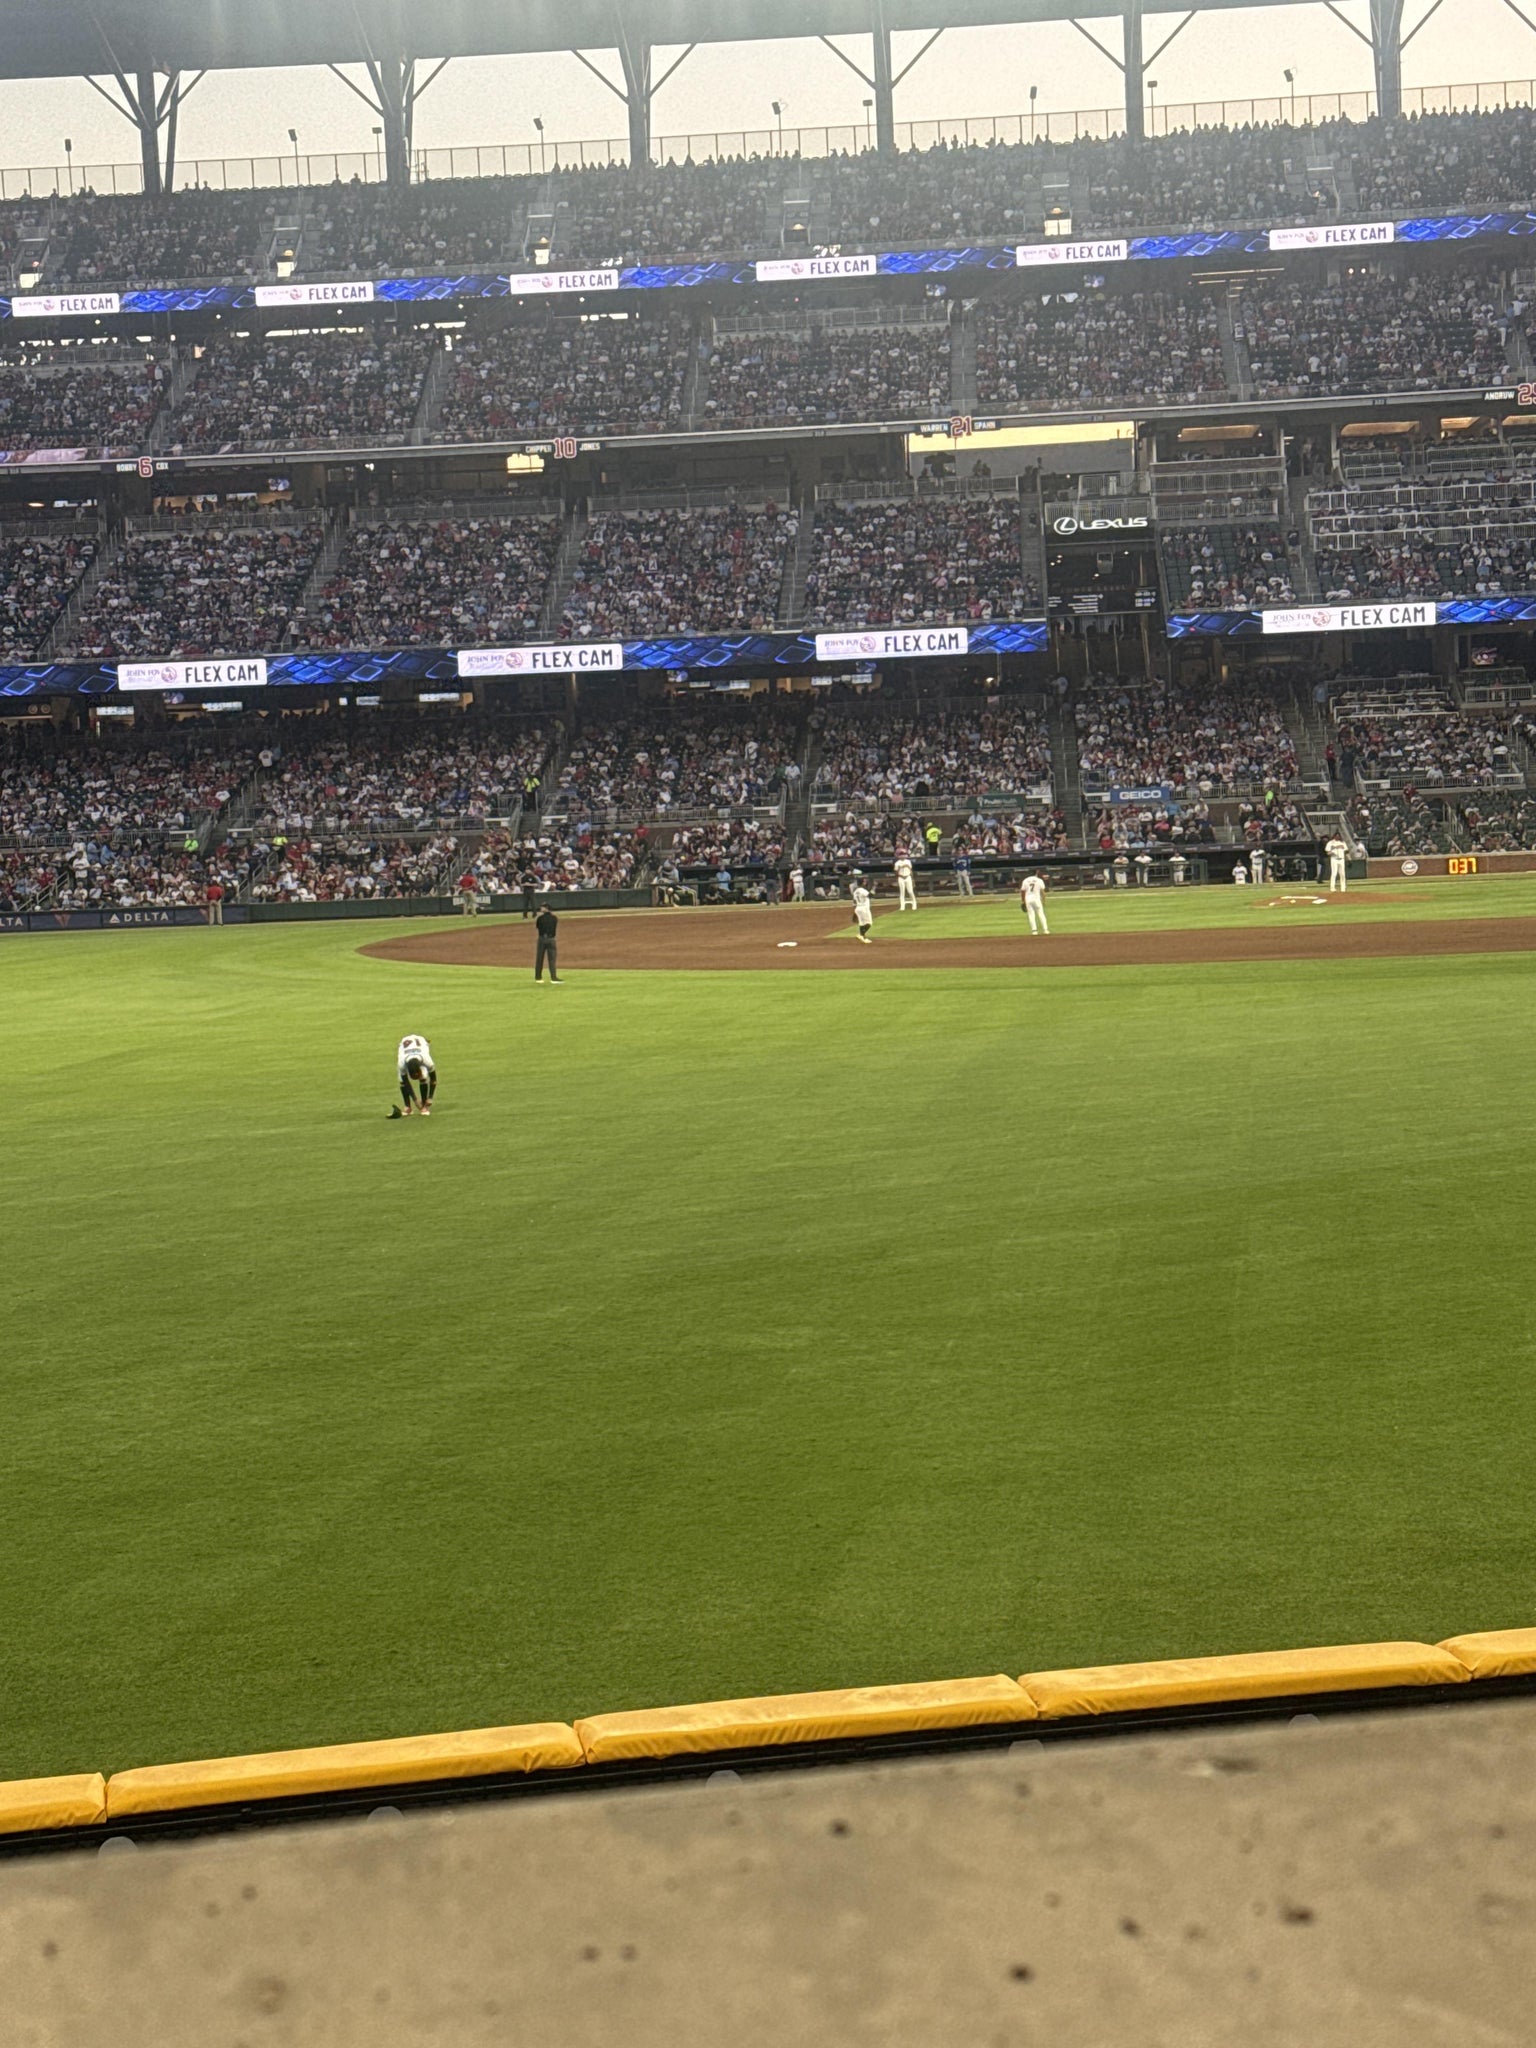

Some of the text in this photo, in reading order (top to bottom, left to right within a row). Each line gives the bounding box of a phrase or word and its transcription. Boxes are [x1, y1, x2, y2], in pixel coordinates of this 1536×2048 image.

[1325, 227, 1387, 242] FLEX CAM
[1066, 244, 1121, 259] FLEX CAM
[810, 260, 869, 274] FLEX CAM
[558, 274, 612, 288] FLEX CAM
[308, 286, 367, 300] FLEX CAM
[60, 297, 113, 311] FLEX CAM
[1517, 383, 1536, 405] 2
[950, 416, 972, 437] 21
[553, 437, 577, 458] 10
[139, 456, 153, 477] 6
[1079, 517, 1148, 530] LEXUS
[1341, 606, 1425, 627] FLEX CAM
[884, 633, 959, 653] FLEX CAM
[532, 649, 613, 669] FLEX CAM
[185, 665, 258, 683] FLEX CAM
[1119, 790, 1162, 800] GEICO
[1448, 857, 1477, 873] 037
[123, 911, 169, 922] DELTA
